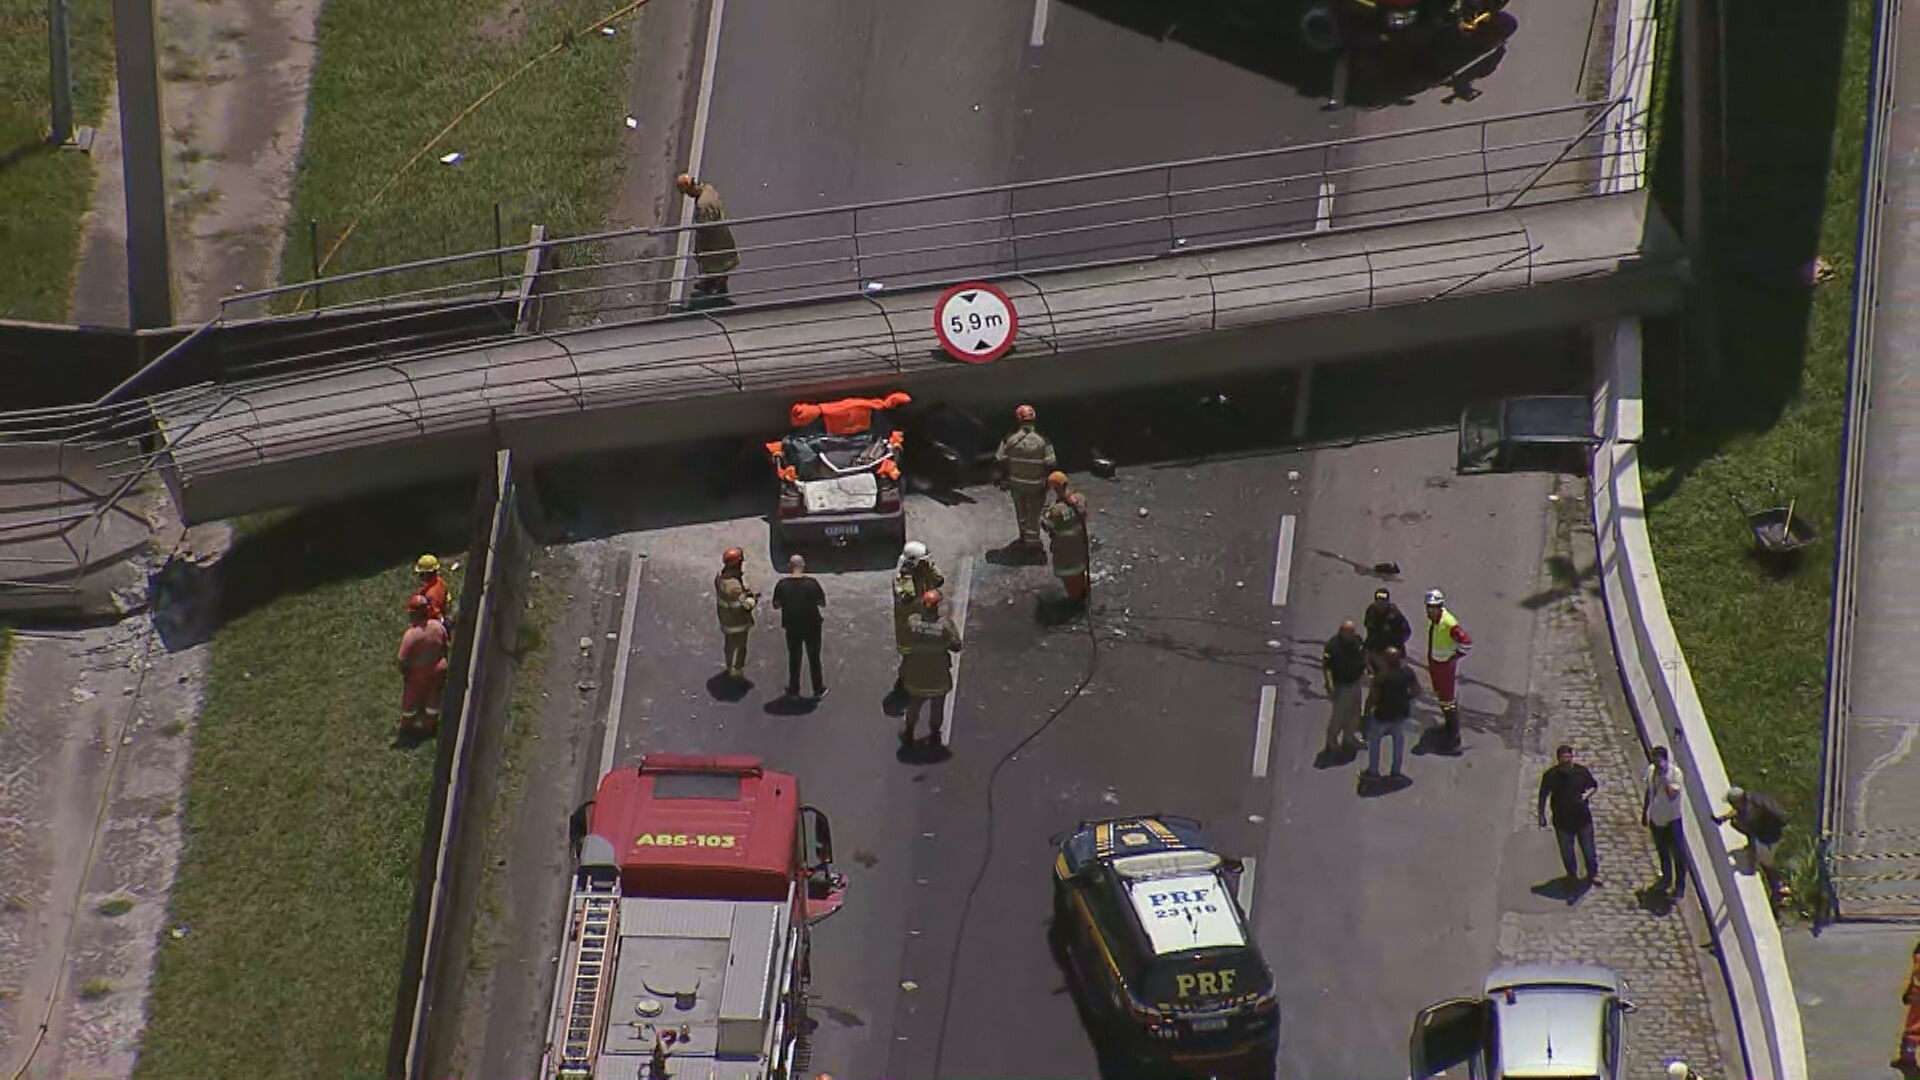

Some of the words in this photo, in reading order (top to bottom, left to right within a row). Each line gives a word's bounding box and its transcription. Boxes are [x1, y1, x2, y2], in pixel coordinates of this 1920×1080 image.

[951, 313, 982, 334] 5,9
[985, 314, 1003, 328] m
[636, 833, 736, 848] ABS-103
[1148, 889, 1209, 906] PRF
[1176, 970, 1236, 998] PRF
